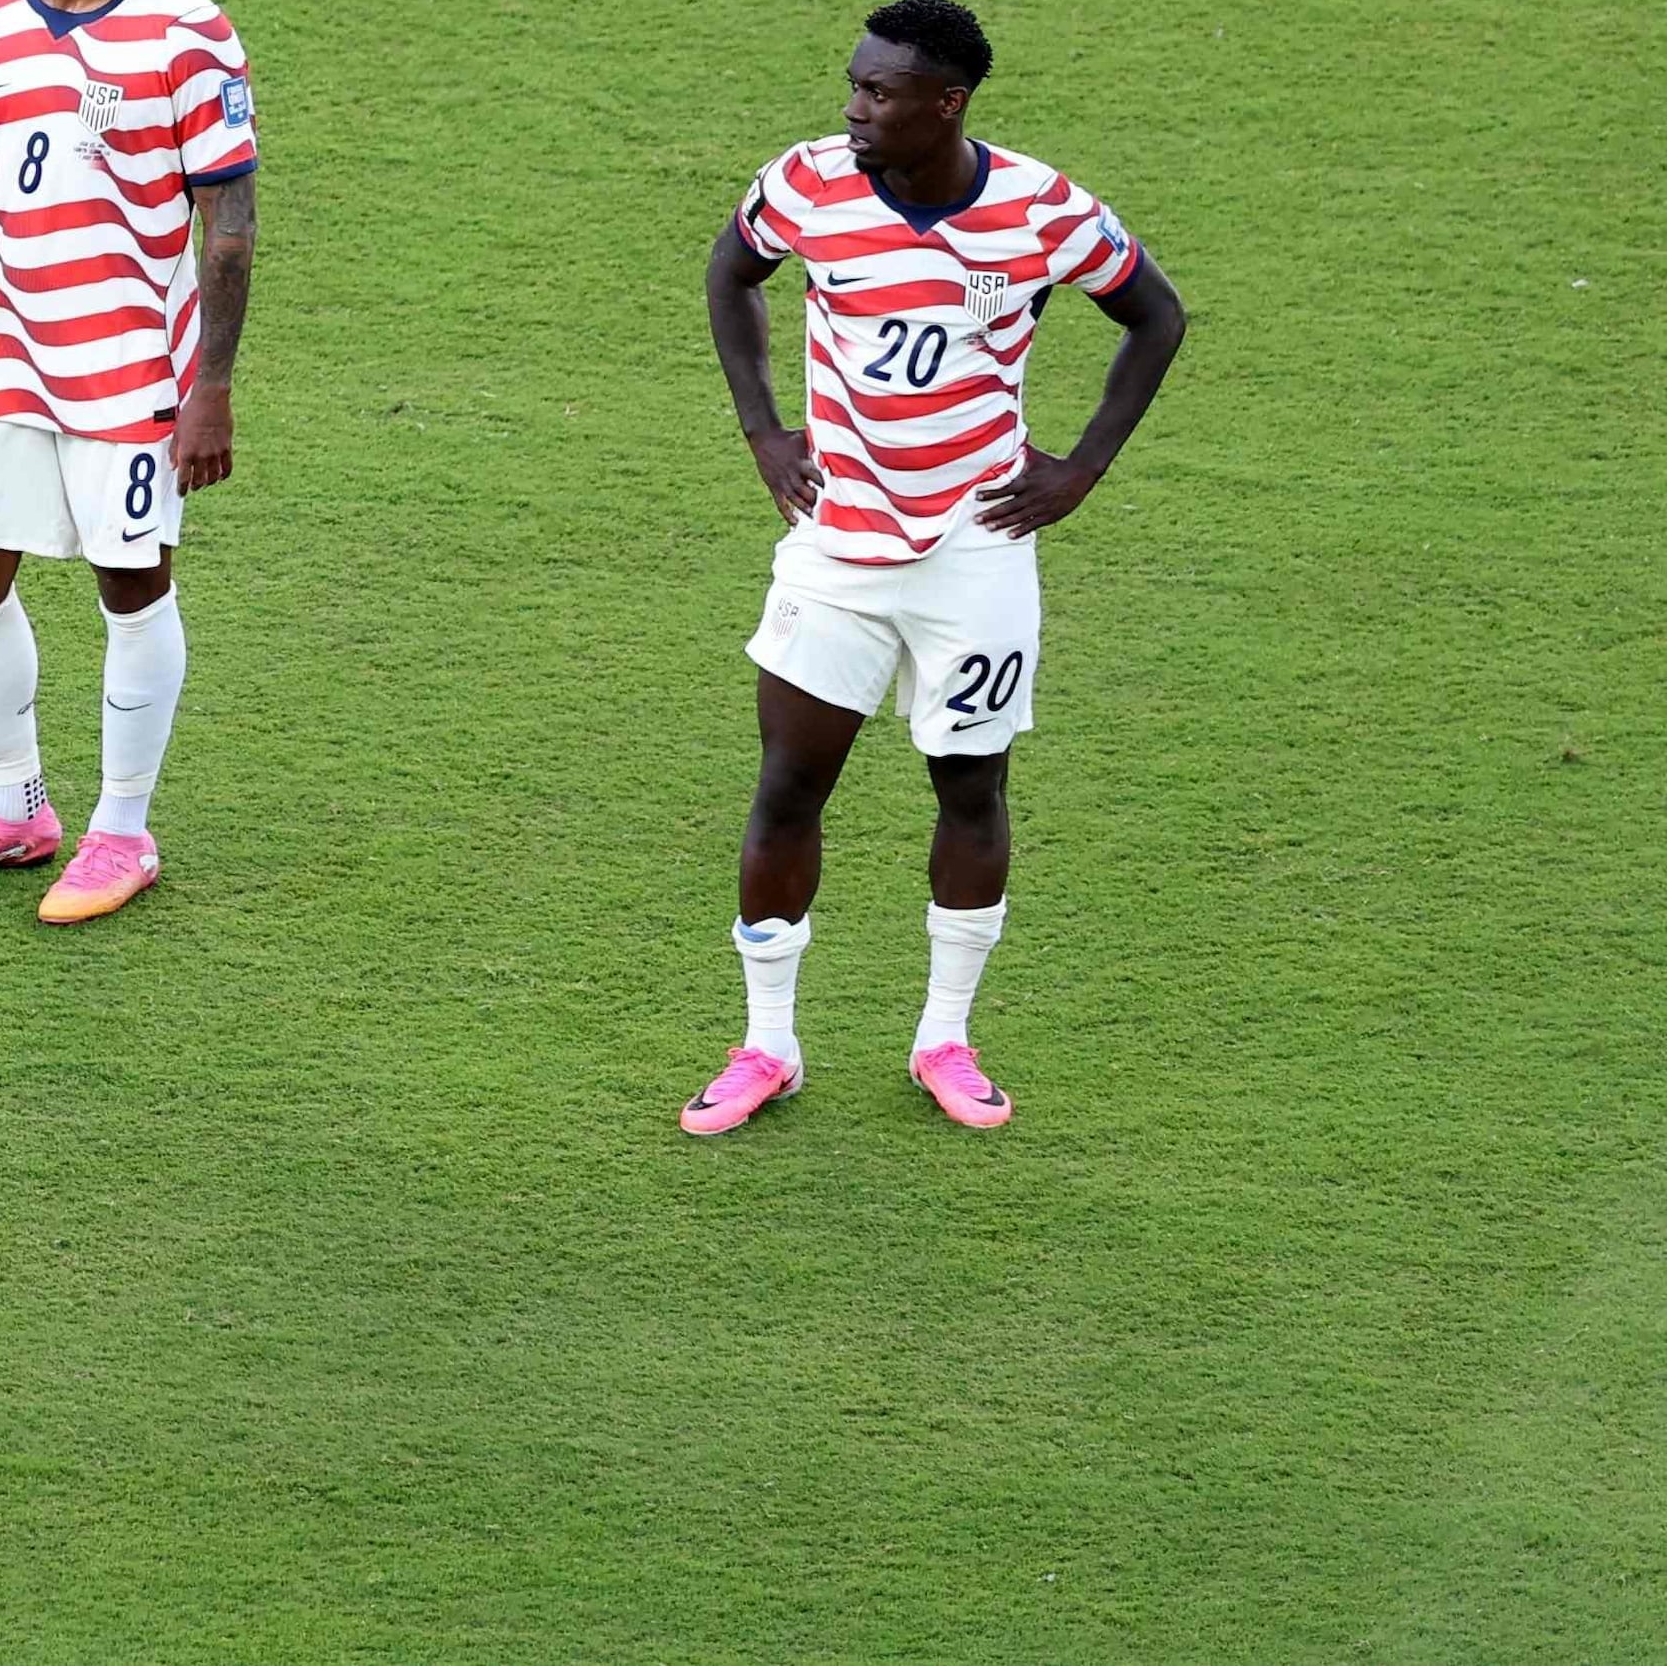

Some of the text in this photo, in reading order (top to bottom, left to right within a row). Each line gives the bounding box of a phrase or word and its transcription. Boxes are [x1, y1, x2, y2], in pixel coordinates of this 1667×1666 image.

[86, 83, 119, 105] USA
[18, 131, 49, 194] 8
[969, 274, 1005, 295] USA
[862, 319, 948, 389] 20
[124, 452, 156, 520] 8
[946, 650, 1023, 714] 20
